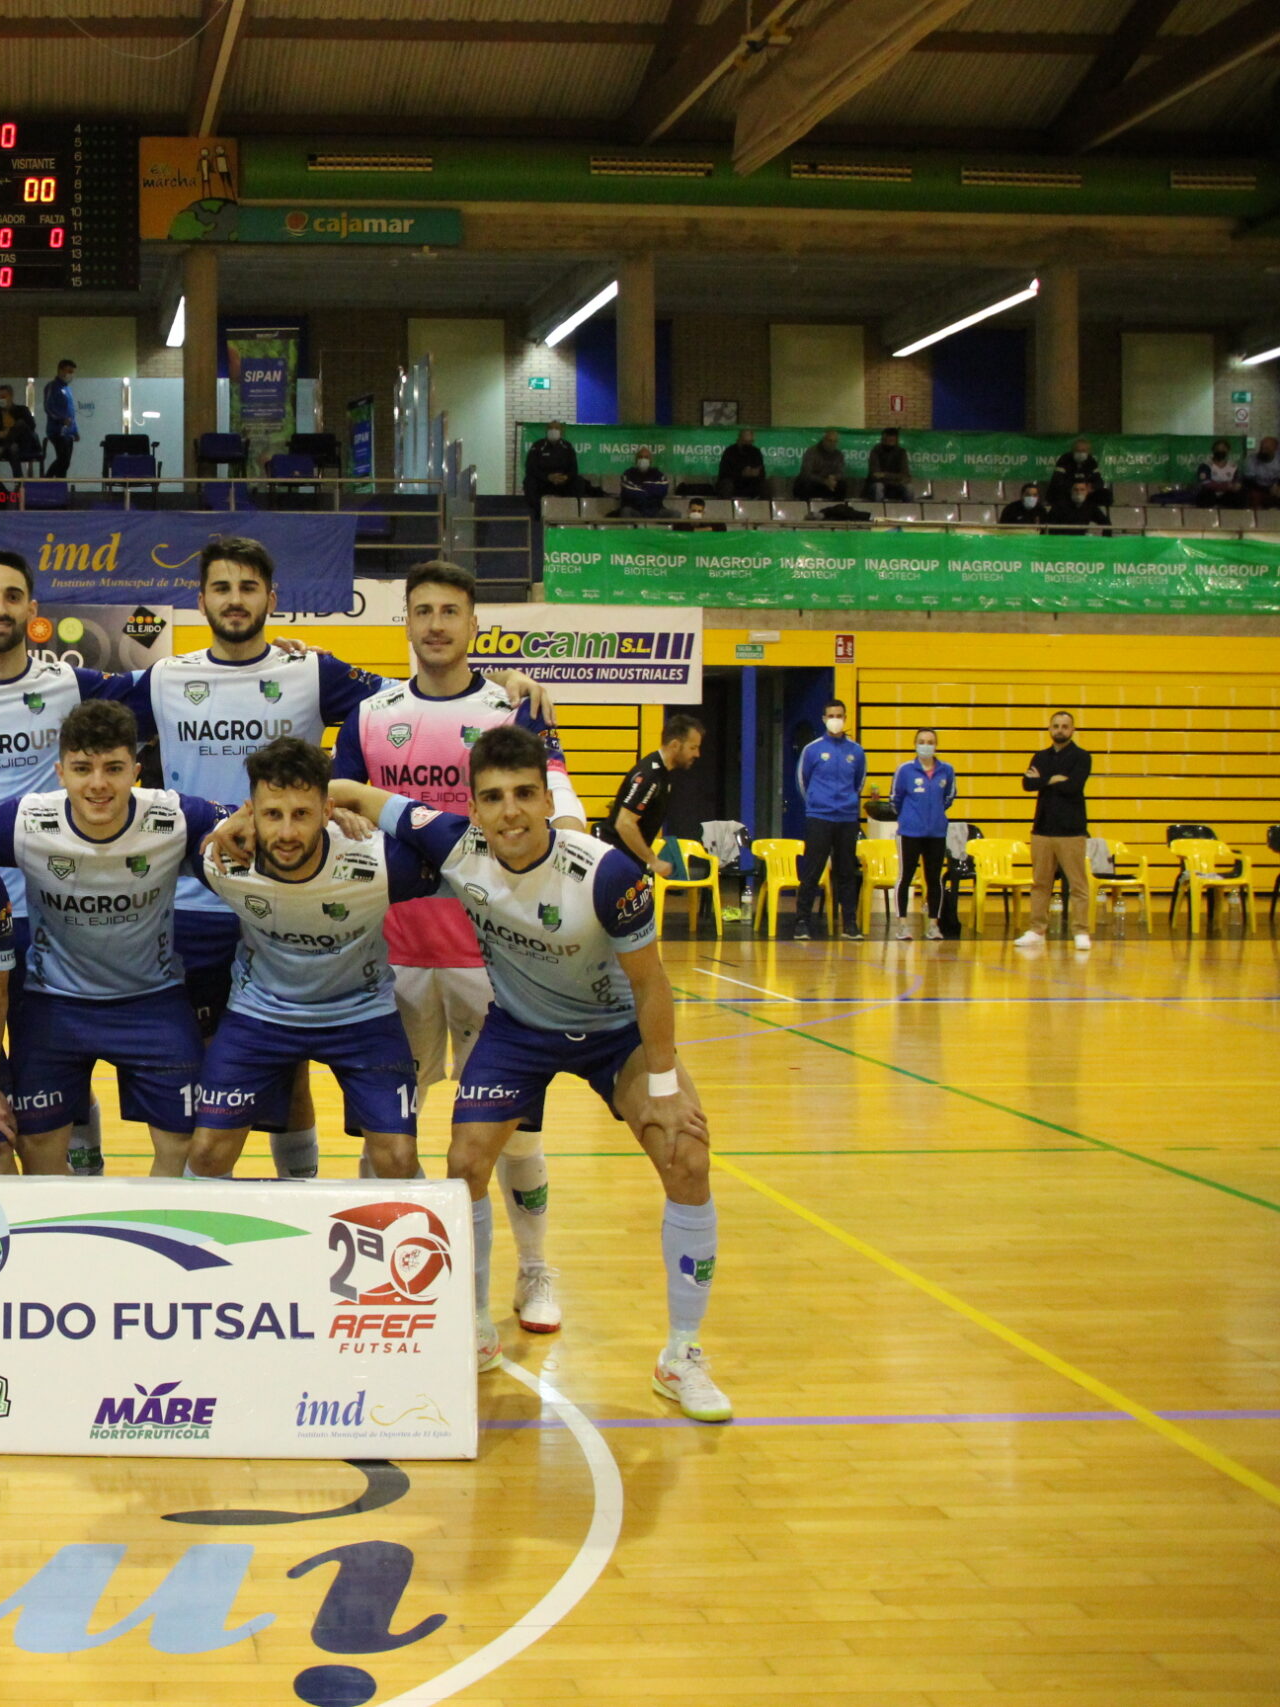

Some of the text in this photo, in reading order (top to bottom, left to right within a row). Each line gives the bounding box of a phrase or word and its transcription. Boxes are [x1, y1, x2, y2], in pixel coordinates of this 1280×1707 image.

[74, 124, 82, 134] 4
[74, 138, 82, 148] 5
[74, 151, 82, 161] 6
[11, 158, 56, 170] VISITANTE
[74, 166, 82, 176] 7
[24, 177, 56, 203] 00
[74, 179, 82, 189] 8
[74, 193, 82, 203] 9
[71, 207, 82, 217] 10
[40, 214, 65, 224] FALTA
[313, 212, 415, 238] cajamar
[71, 221, 82, 231] 11
[49, 228, 65, 248] 0
[71, 235, 82, 245] 12
[71, 249, 82, 258] 13
[71, 263, 82, 273] 14
[71, 277, 82, 287] 15
[244, 370, 282, 384] SIPAN
[39, 532, 122, 572] imd
[610, 554, 687, 568] INAGROUP
[695, 555, 772, 570] INAGROUP
[864, 558, 940, 573] INAGROUP
[948, 560, 1022, 574] INAGROUP
[624, 566, 668, 577] BIOTECH
[1030, 561, 1106, 575] INAGROUP
[1113, 562, 1188, 576] INAGROUP
[1194, 564, 1269, 578] INAGROUP
[51, 576, 170, 588] Instituto Municipal de
[962, 572, 1004, 582] BIOTECH
[126, 624, 162, 634] EL EJIDO
[620, 638, 652, 654] S.L.
[523, 664, 593, 680] VEHÍCULOS
[596, 667, 684, 681] INDUSTRIALES
[178, 719, 292, 742] INAGROUP
[198, 746, 218, 756] EL
[422, 792, 468, 802] EJIDO
[40, 886, 161, 914] INAGROUP
[64, 914, 139, 926] EL EJIDO
[114, 1302, 314, 1340] FUTSAL
[328, 1314, 437, 1339] RFEF
[338, 1342, 422, 1354] FUTSAL
[296, 1390, 366, 1427] imd
[90, 1426, 211, 1440] HORTOFRUTICOLA
[297, 1430, 329, 1438] Instituto
[330, 1431, 366, 1440] Municipal
[378, 1430, 411, 1439] Deportes
